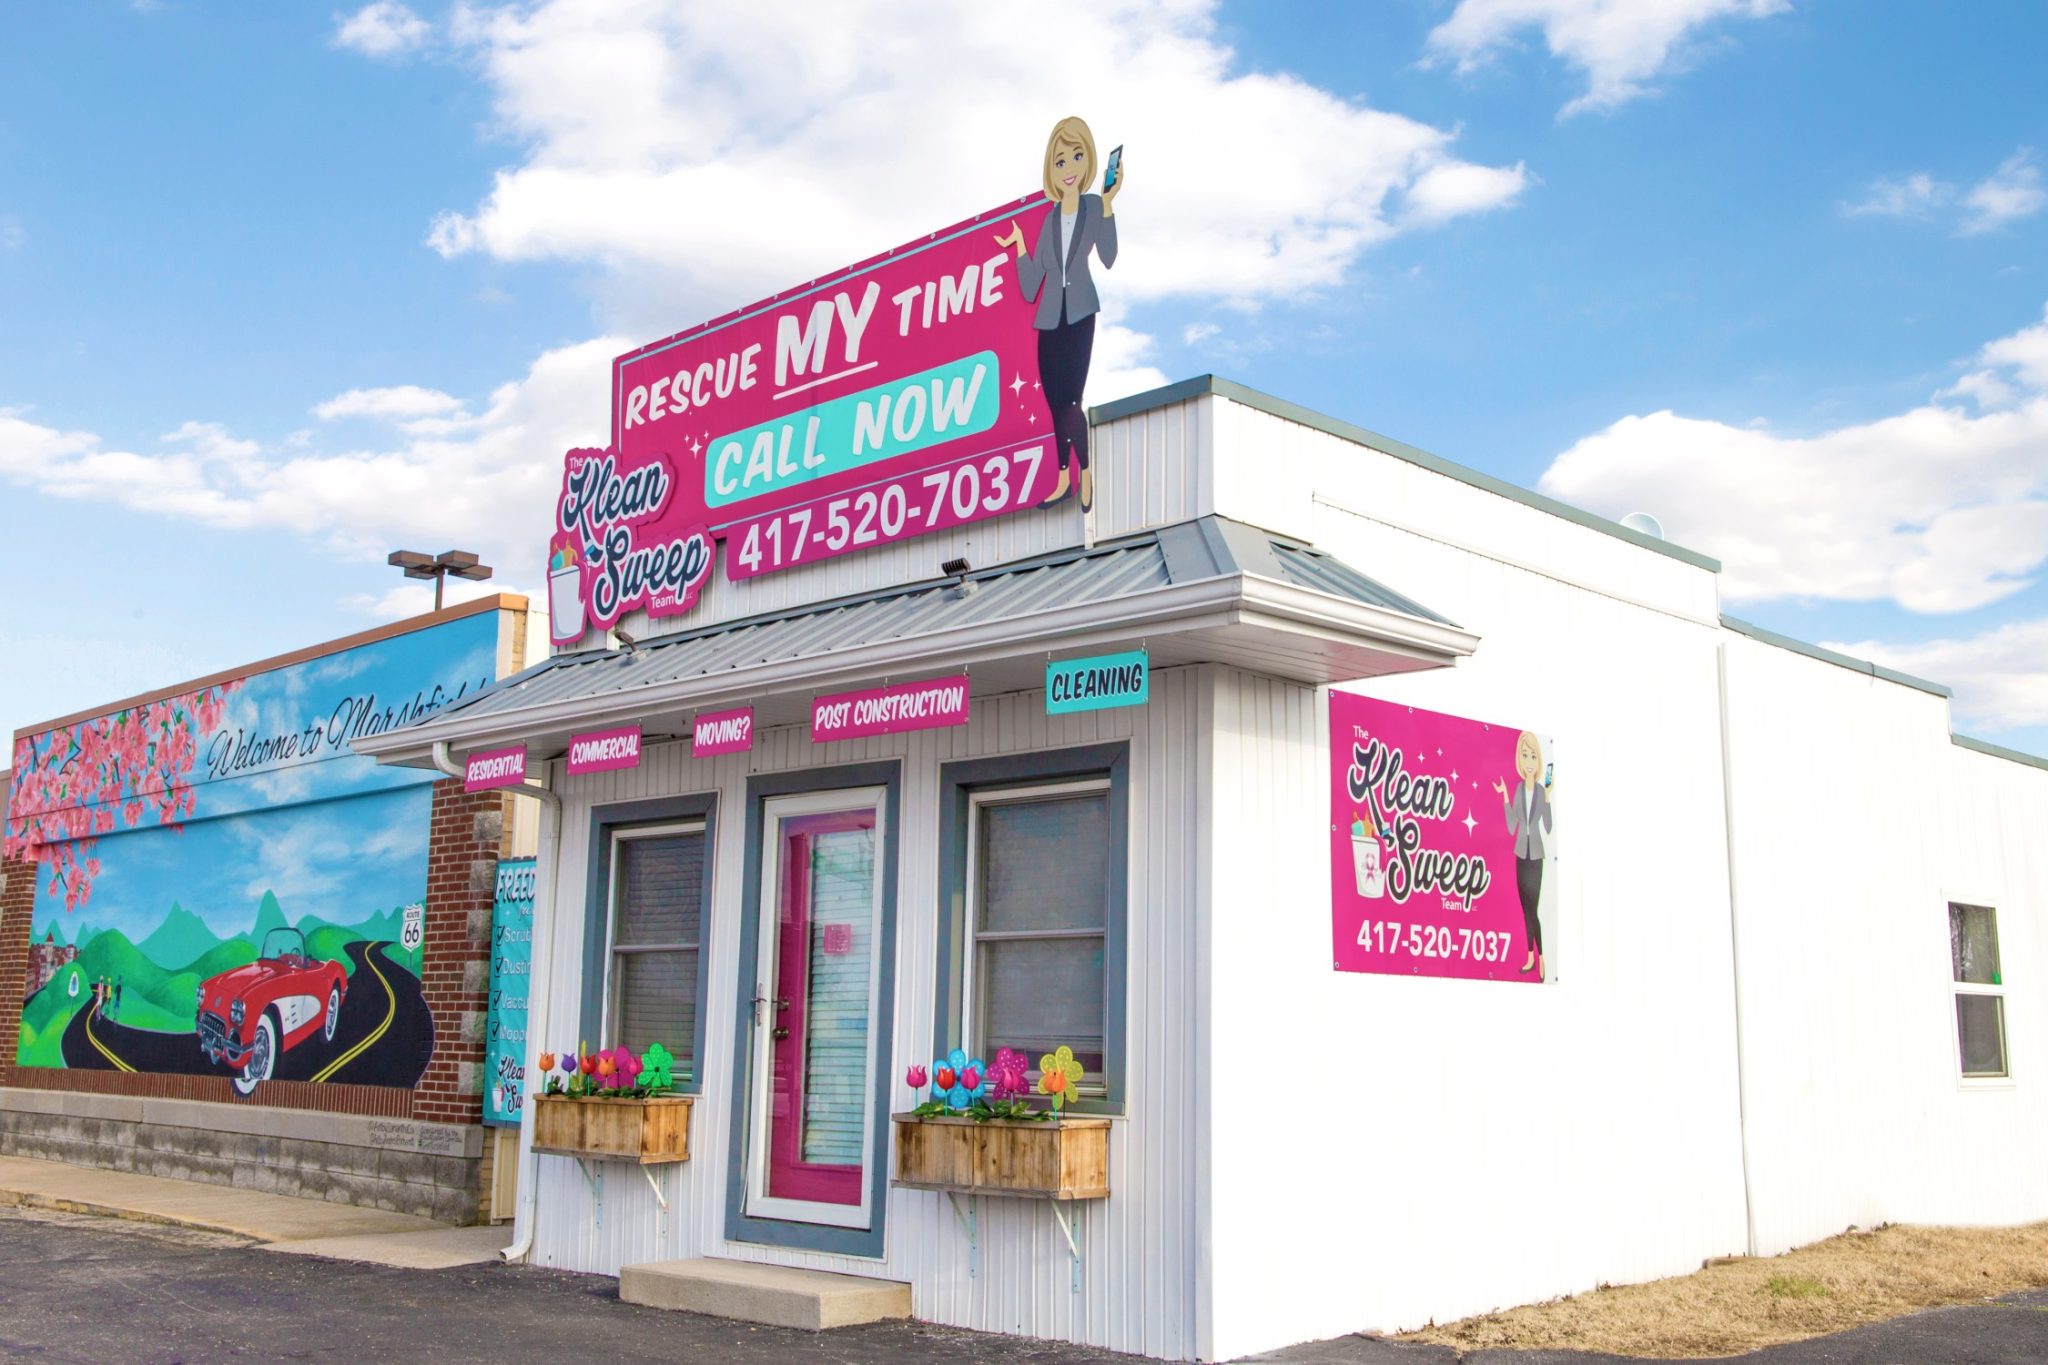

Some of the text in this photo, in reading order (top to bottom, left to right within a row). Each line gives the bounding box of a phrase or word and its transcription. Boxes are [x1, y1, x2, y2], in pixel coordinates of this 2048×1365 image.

[625, 253, 1009, 429] RESCUE MY TIME
[714, 364, 987, 496] CALL NOW
[569, 457, 583, 469] The
[561, 455, 669, 538] Klean
[738, 446, 1044, 572] 417-520-7037
[593, 525, 710, 621] Sweep
[651, 595, 674, 609] Team
[1051, 663, 1143, 703] CLEANING
[815, 686, 964, 731] POST CONSTRUCTION
[207, 729, 298, 780] Welcome
[299, 725, 323, 757] to
[571, 734, 639, 765] COMMERCIAL
[696, 715, 751, 747] MOVING?
[1352, 725, 1369, 740] The
[467, 756, 524, 783] RESIDENTIAL
[1347, 738, 1454, 825] Klean
[1388, 814, 1490, 912] Sweep
[1441, 897, 1462, 911] Team
[404, 922, 420, 943] 66
[1357, 919, 1511, 962] 417-520-7037
